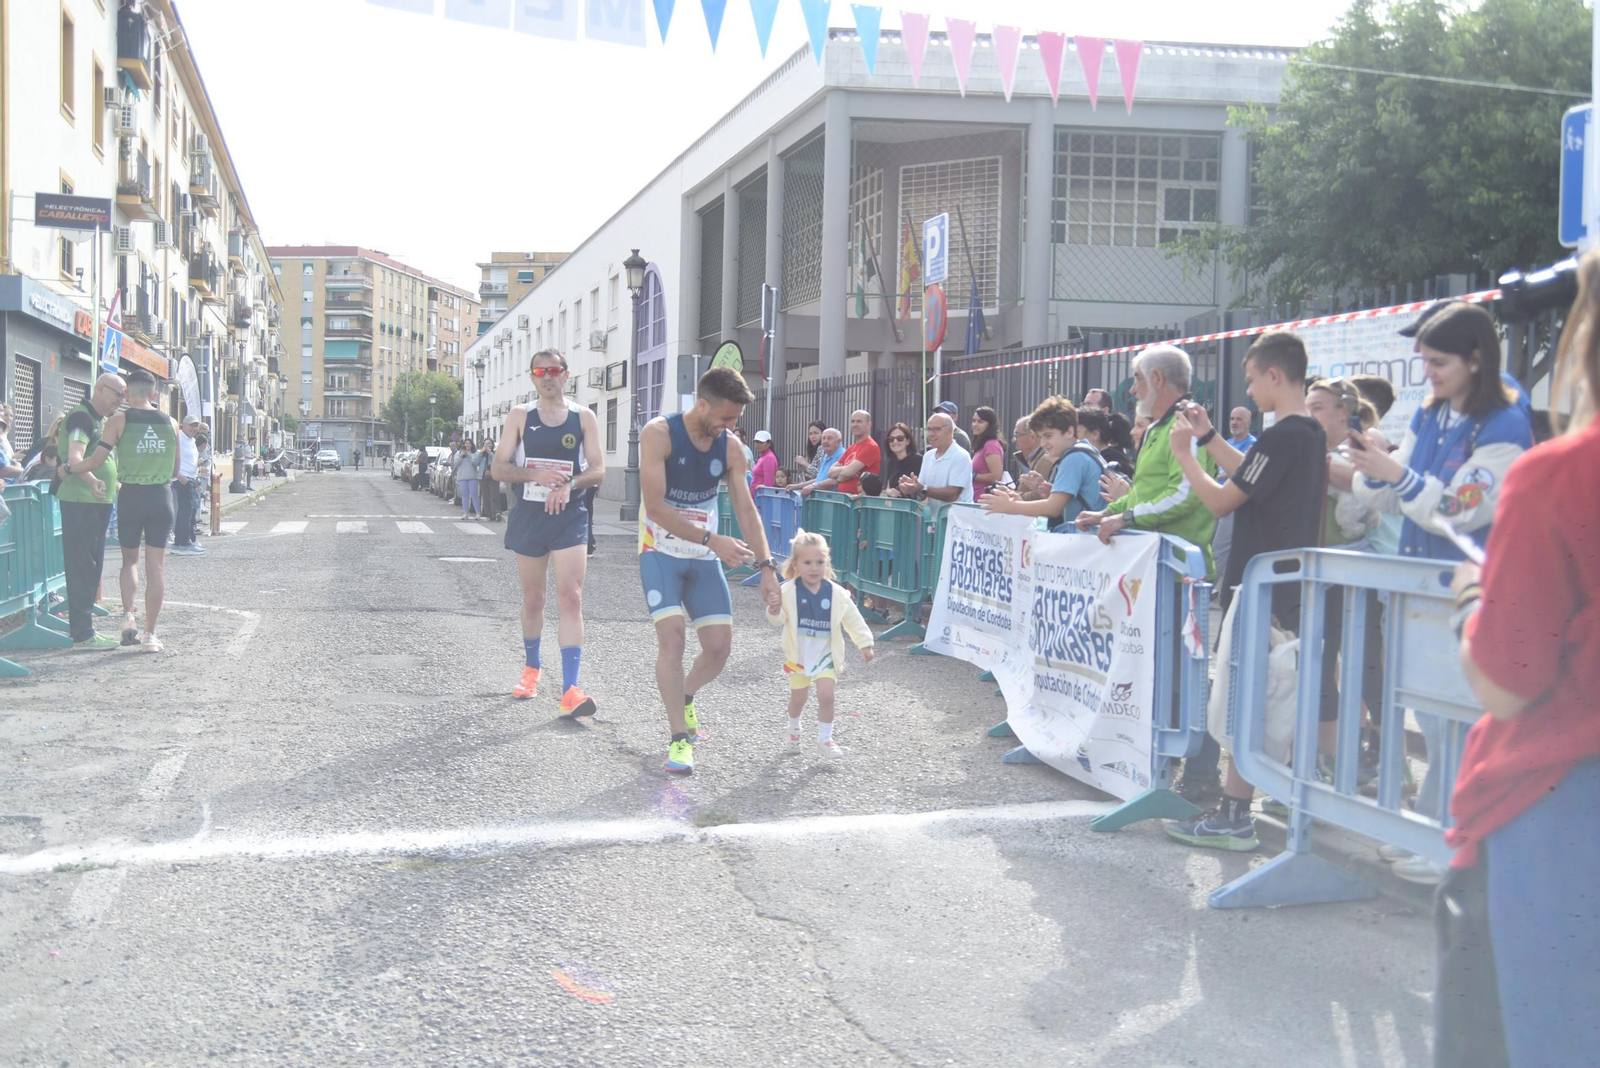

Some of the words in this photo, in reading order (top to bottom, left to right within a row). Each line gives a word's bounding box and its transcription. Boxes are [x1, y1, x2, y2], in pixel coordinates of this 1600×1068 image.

[39, 209, 109, 222] CABALLERO
[926, 225, 940, 276] P
[136, 440, 166, 449] AIRE
[951, 540, 1004, 576] carreras
[1004, 556, 1013, 576] 25
[974, 530, 1003, 548] PROVINCIAL
[1003, 536, 1013, 556] 20
[949, 561, 1013, 603] populares
[1056, 566, 1096, 591] PROVINCIAL
[947, 596, 977, 619] Diputación
[977, 606, 985, 622] de
[986, 607, 1012, 630] Córdoba
[1034, 585, 1094, 633] arreras
[1073, 679, 1082, 703] de
